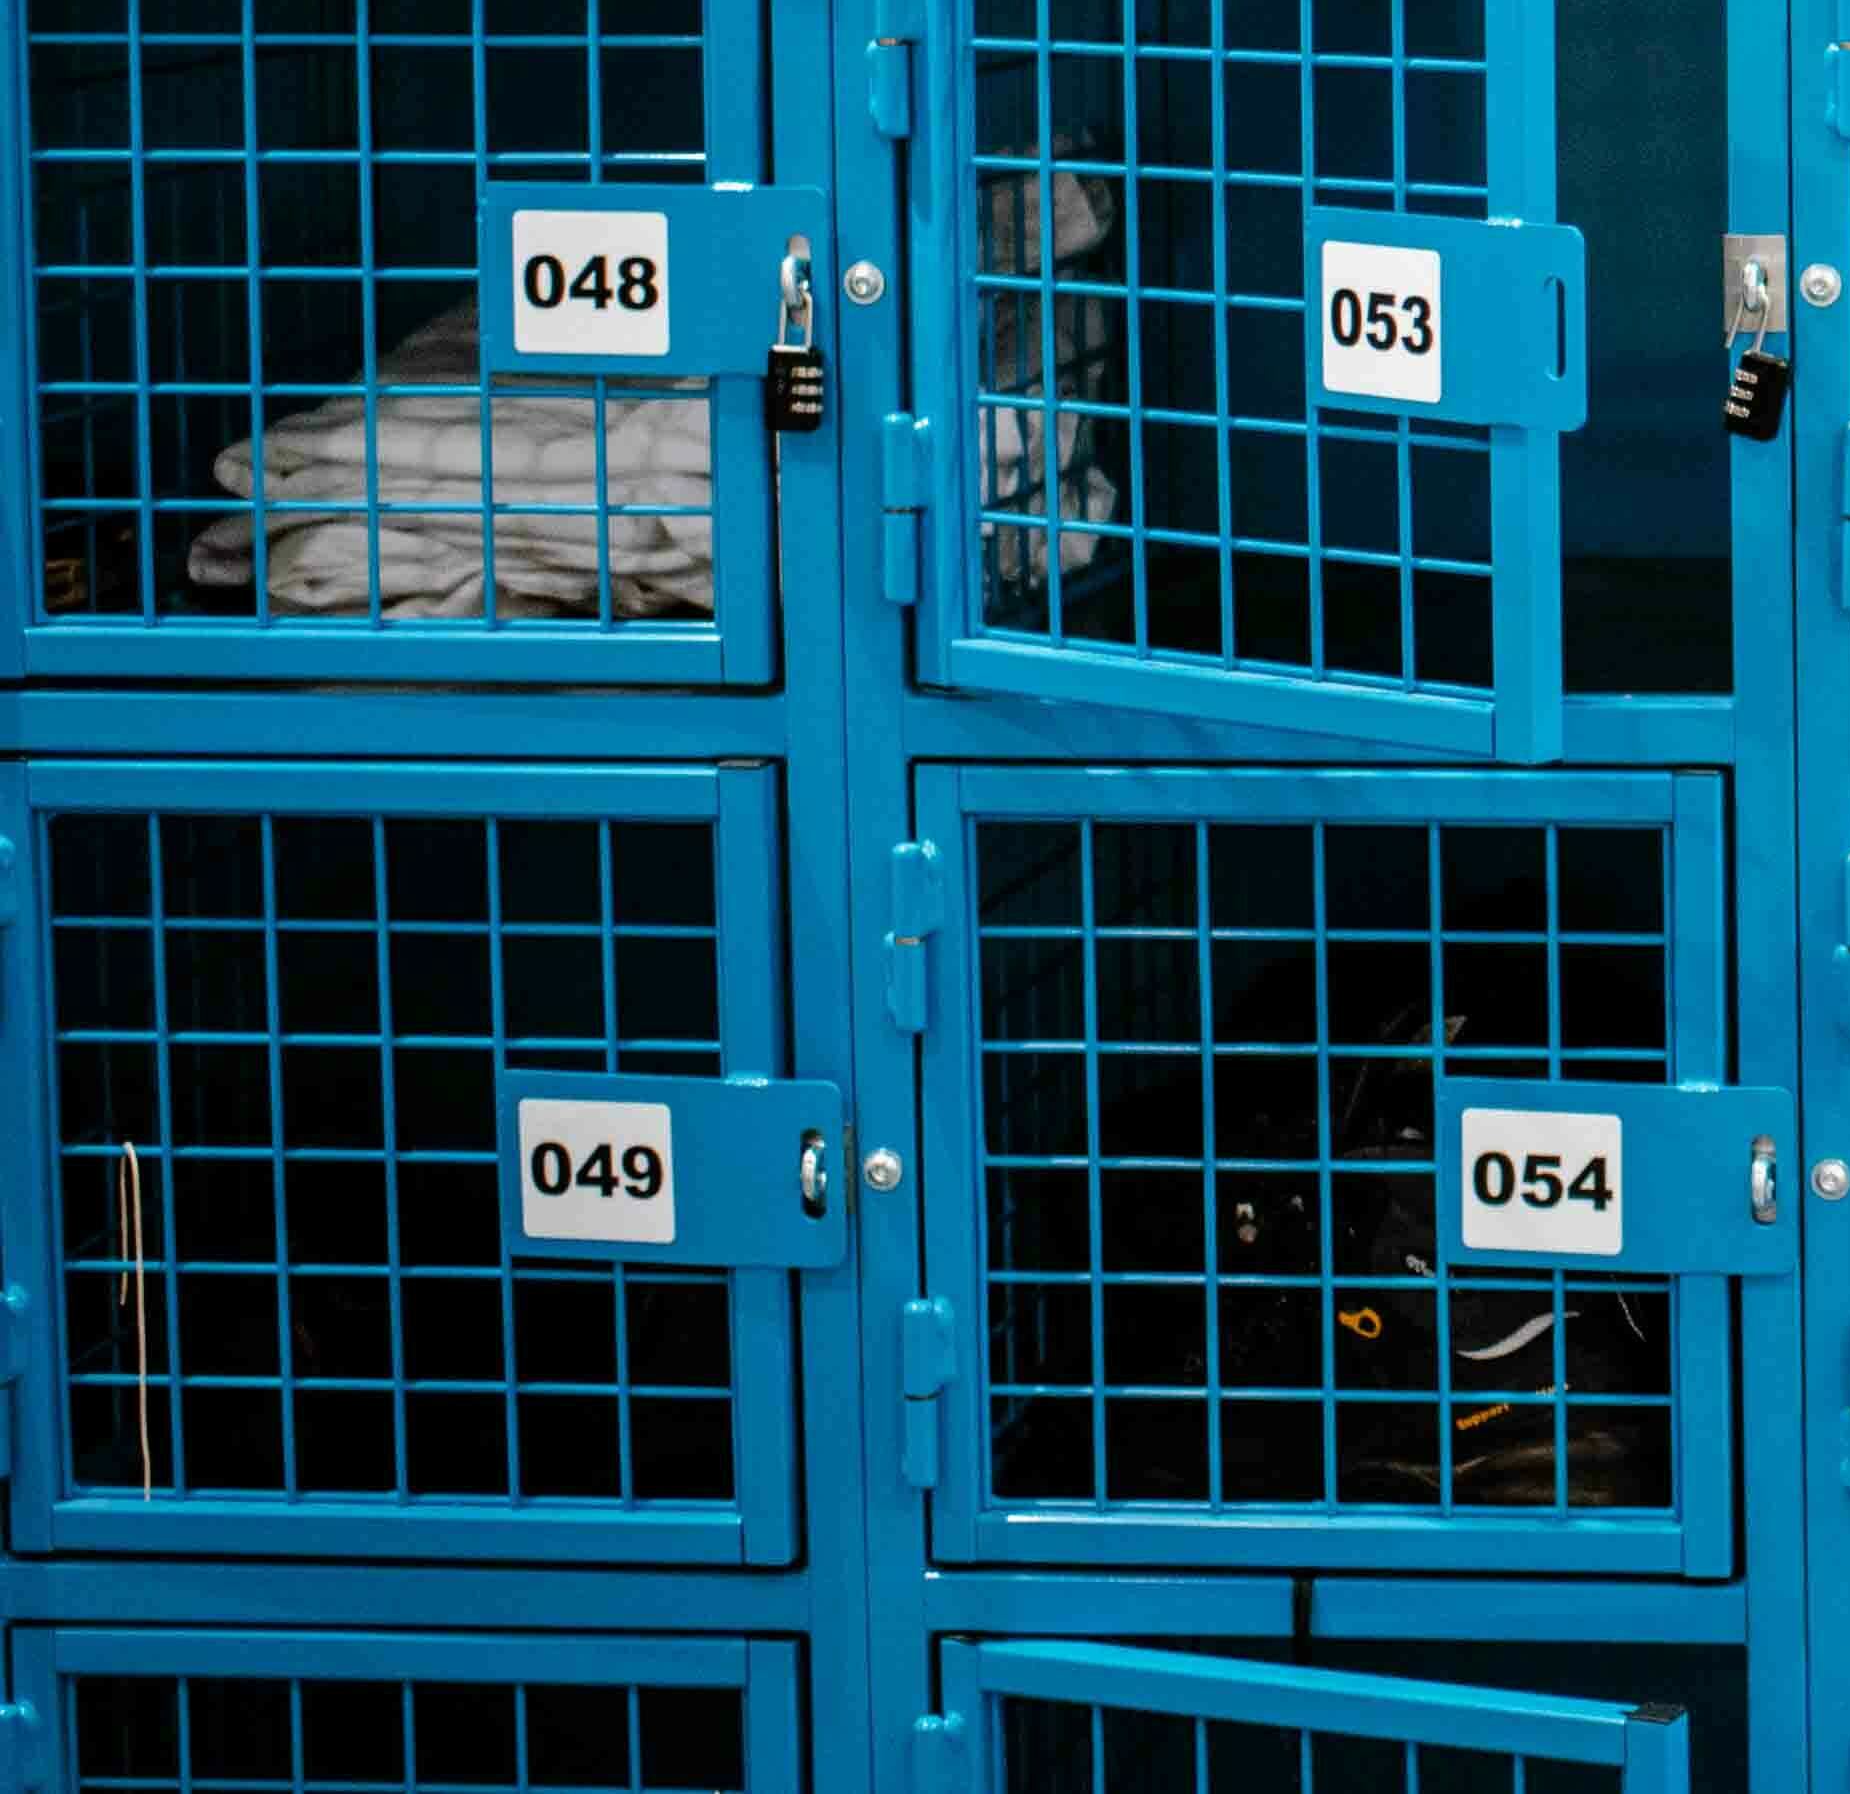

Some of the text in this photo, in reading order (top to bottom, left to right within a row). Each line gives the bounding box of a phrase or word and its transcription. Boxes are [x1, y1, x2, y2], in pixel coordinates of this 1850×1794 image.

[523, 253, 659, 312] 048
[1330, 287, 1434, 356] 053
[529, 1140, 664, 1201] 049
[1472, 1150, 1614, 1212] 054
